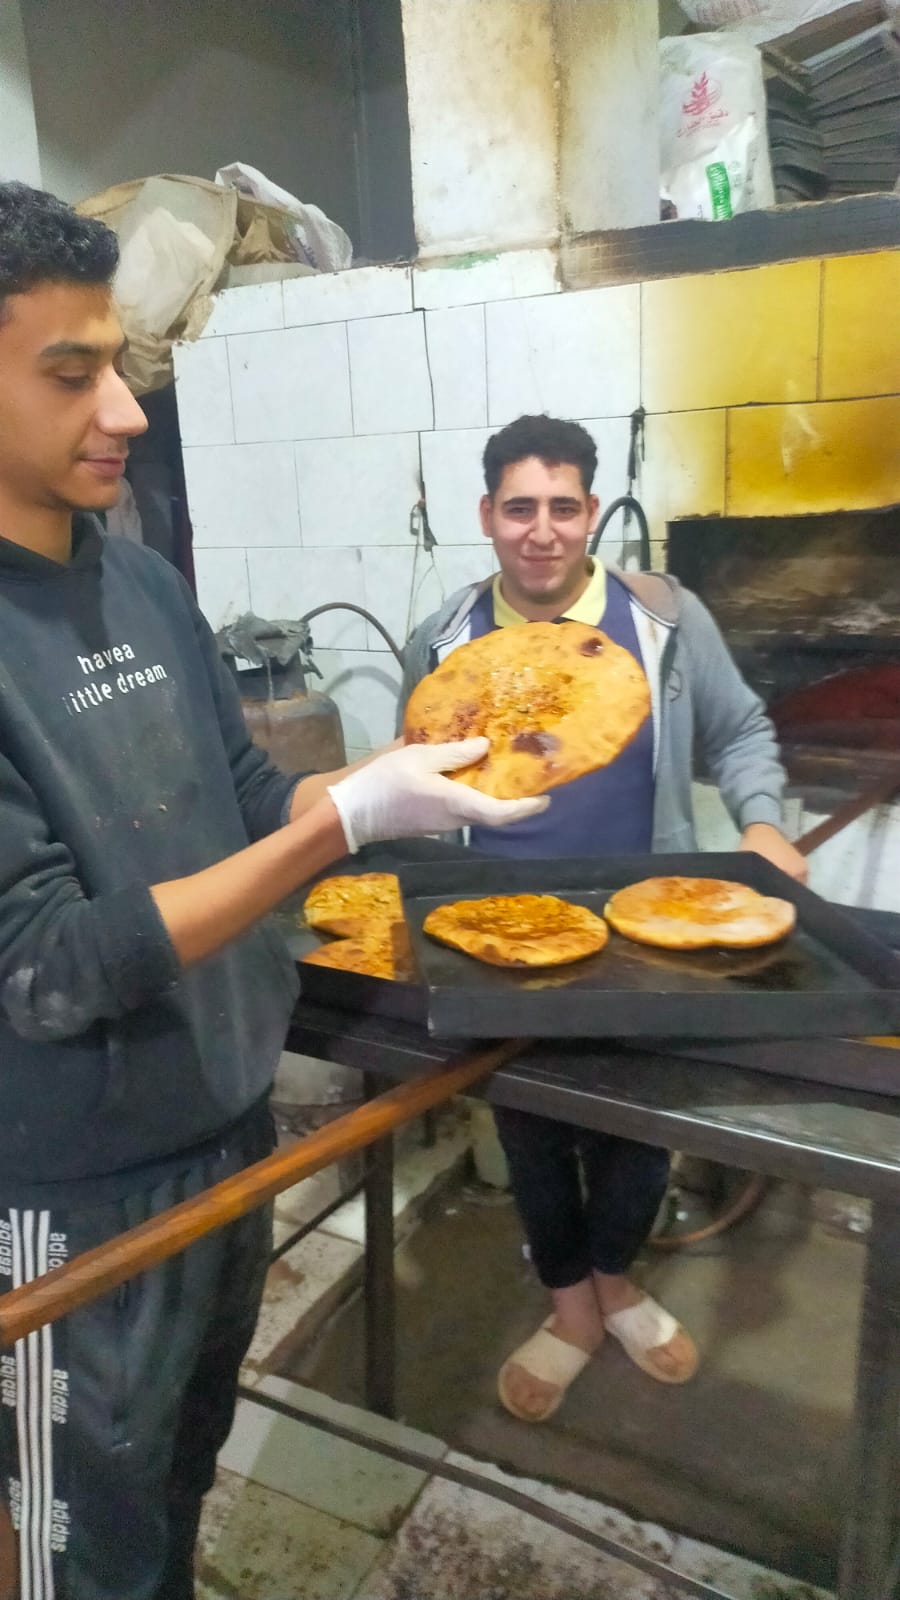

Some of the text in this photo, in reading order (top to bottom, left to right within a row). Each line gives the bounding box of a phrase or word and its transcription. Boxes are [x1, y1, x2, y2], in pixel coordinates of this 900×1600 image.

[62, 664, 167, 716] little dream
[48, 1233, 68, 1272] adid
[51, 1369, 69, 1424] adidas
